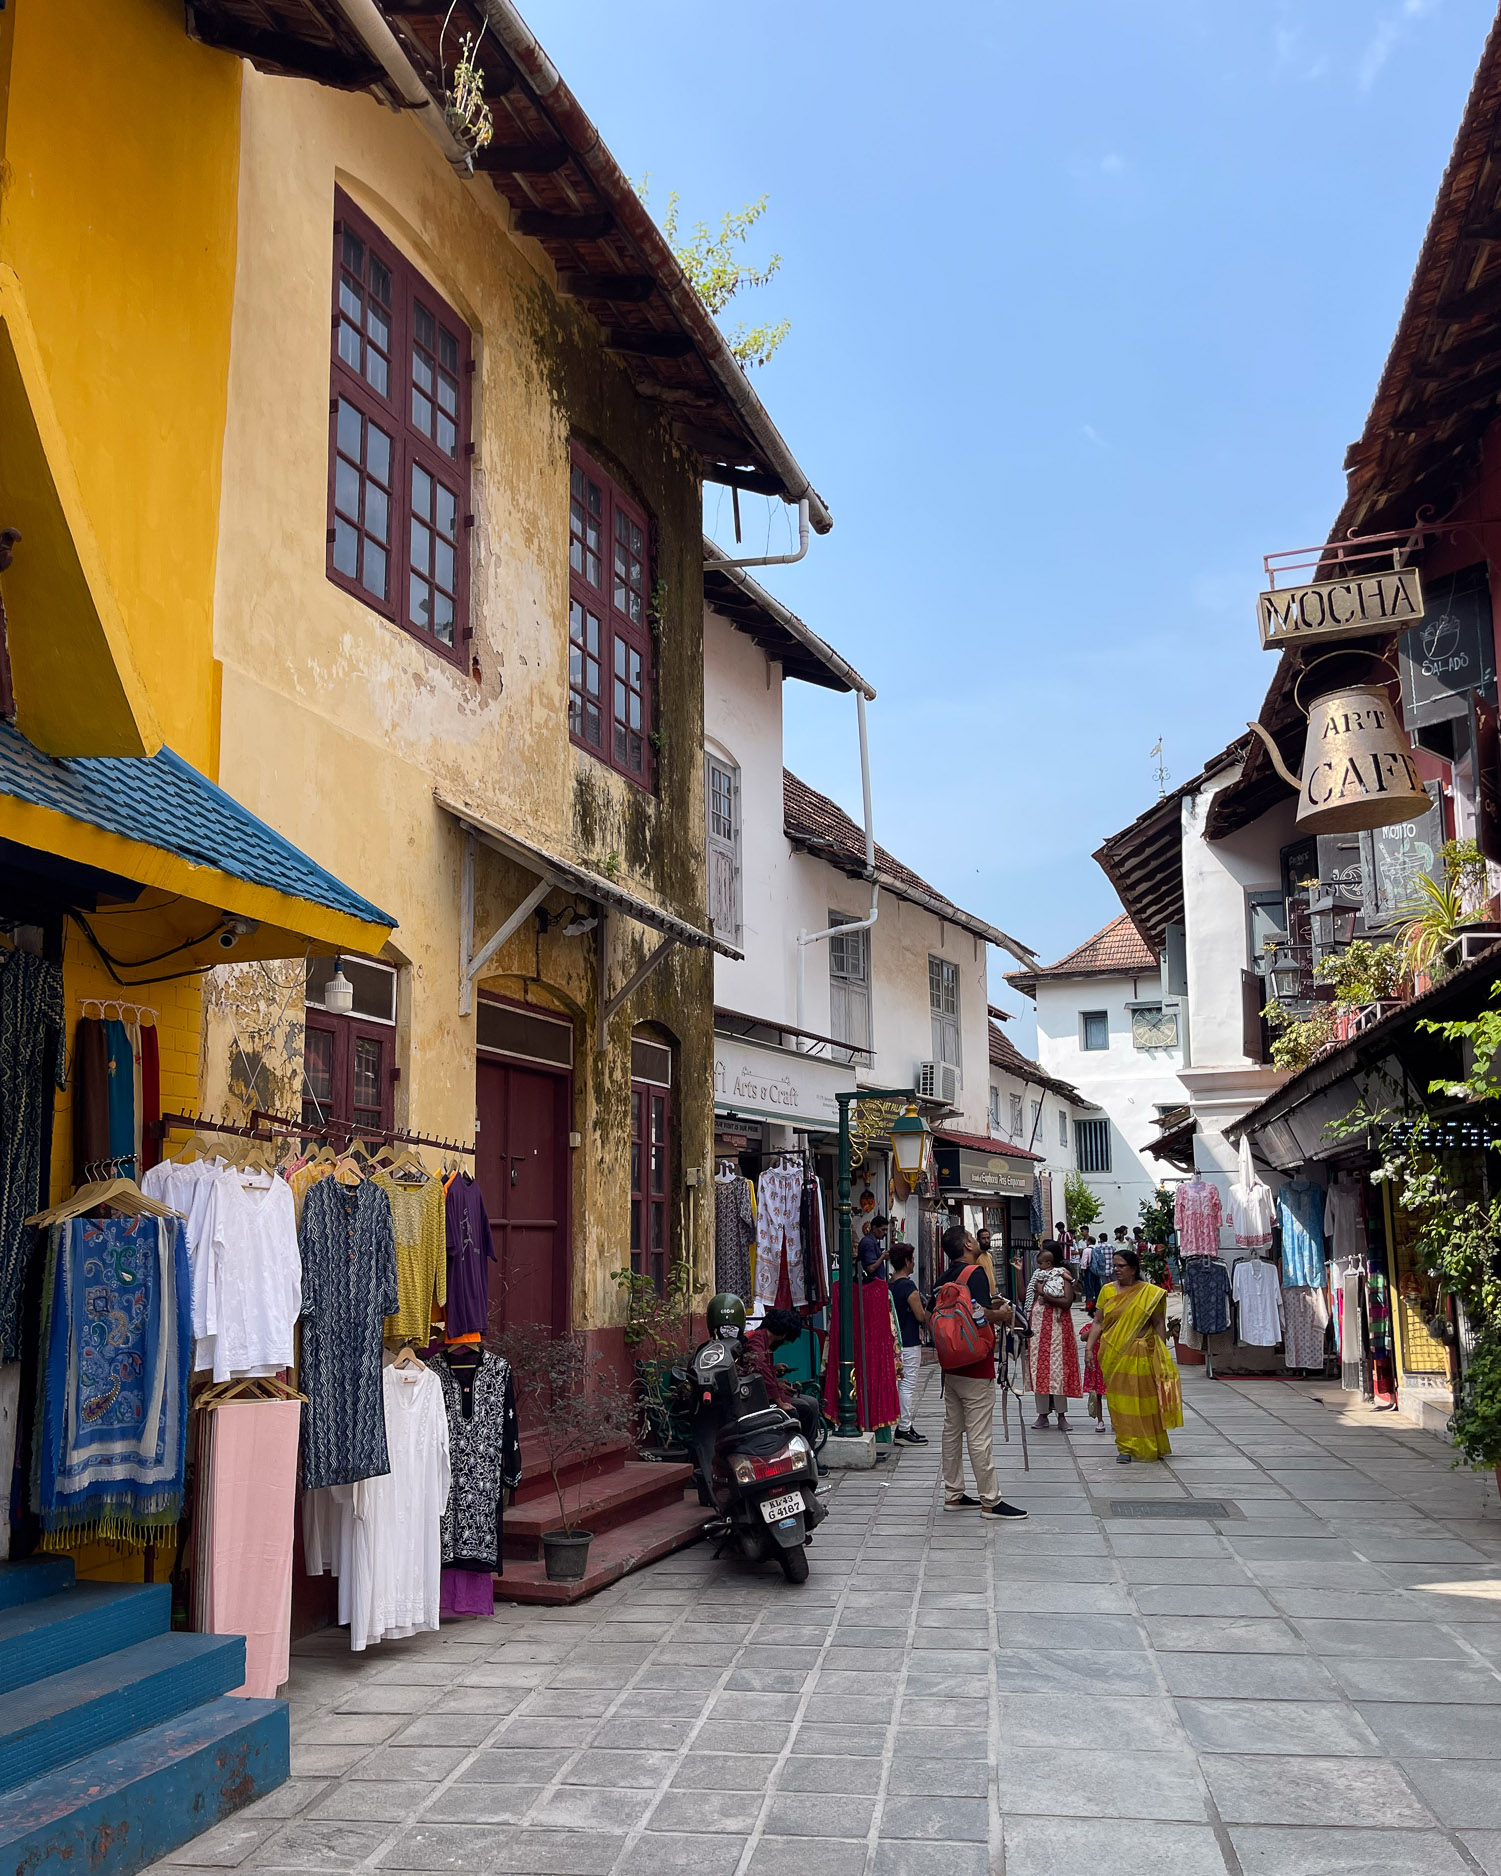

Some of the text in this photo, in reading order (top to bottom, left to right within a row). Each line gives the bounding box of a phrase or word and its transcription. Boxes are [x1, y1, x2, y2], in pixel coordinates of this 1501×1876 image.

[1264, 576, 1416, 636] MOCHA
[1421, 652, 1469, 676] SALADS
[1322, 710, 1385, 740] ART
[1308, 752, 1428, 806] CAFE
[1382, 823, 1416, 840] MOJITO
[733, 1076, 757, 1100] Arts
[760, 1086, 768, 1101] &
[769, 1084, 799, 1107] Craft
[768, 1502, 800, 1520] G 4187
